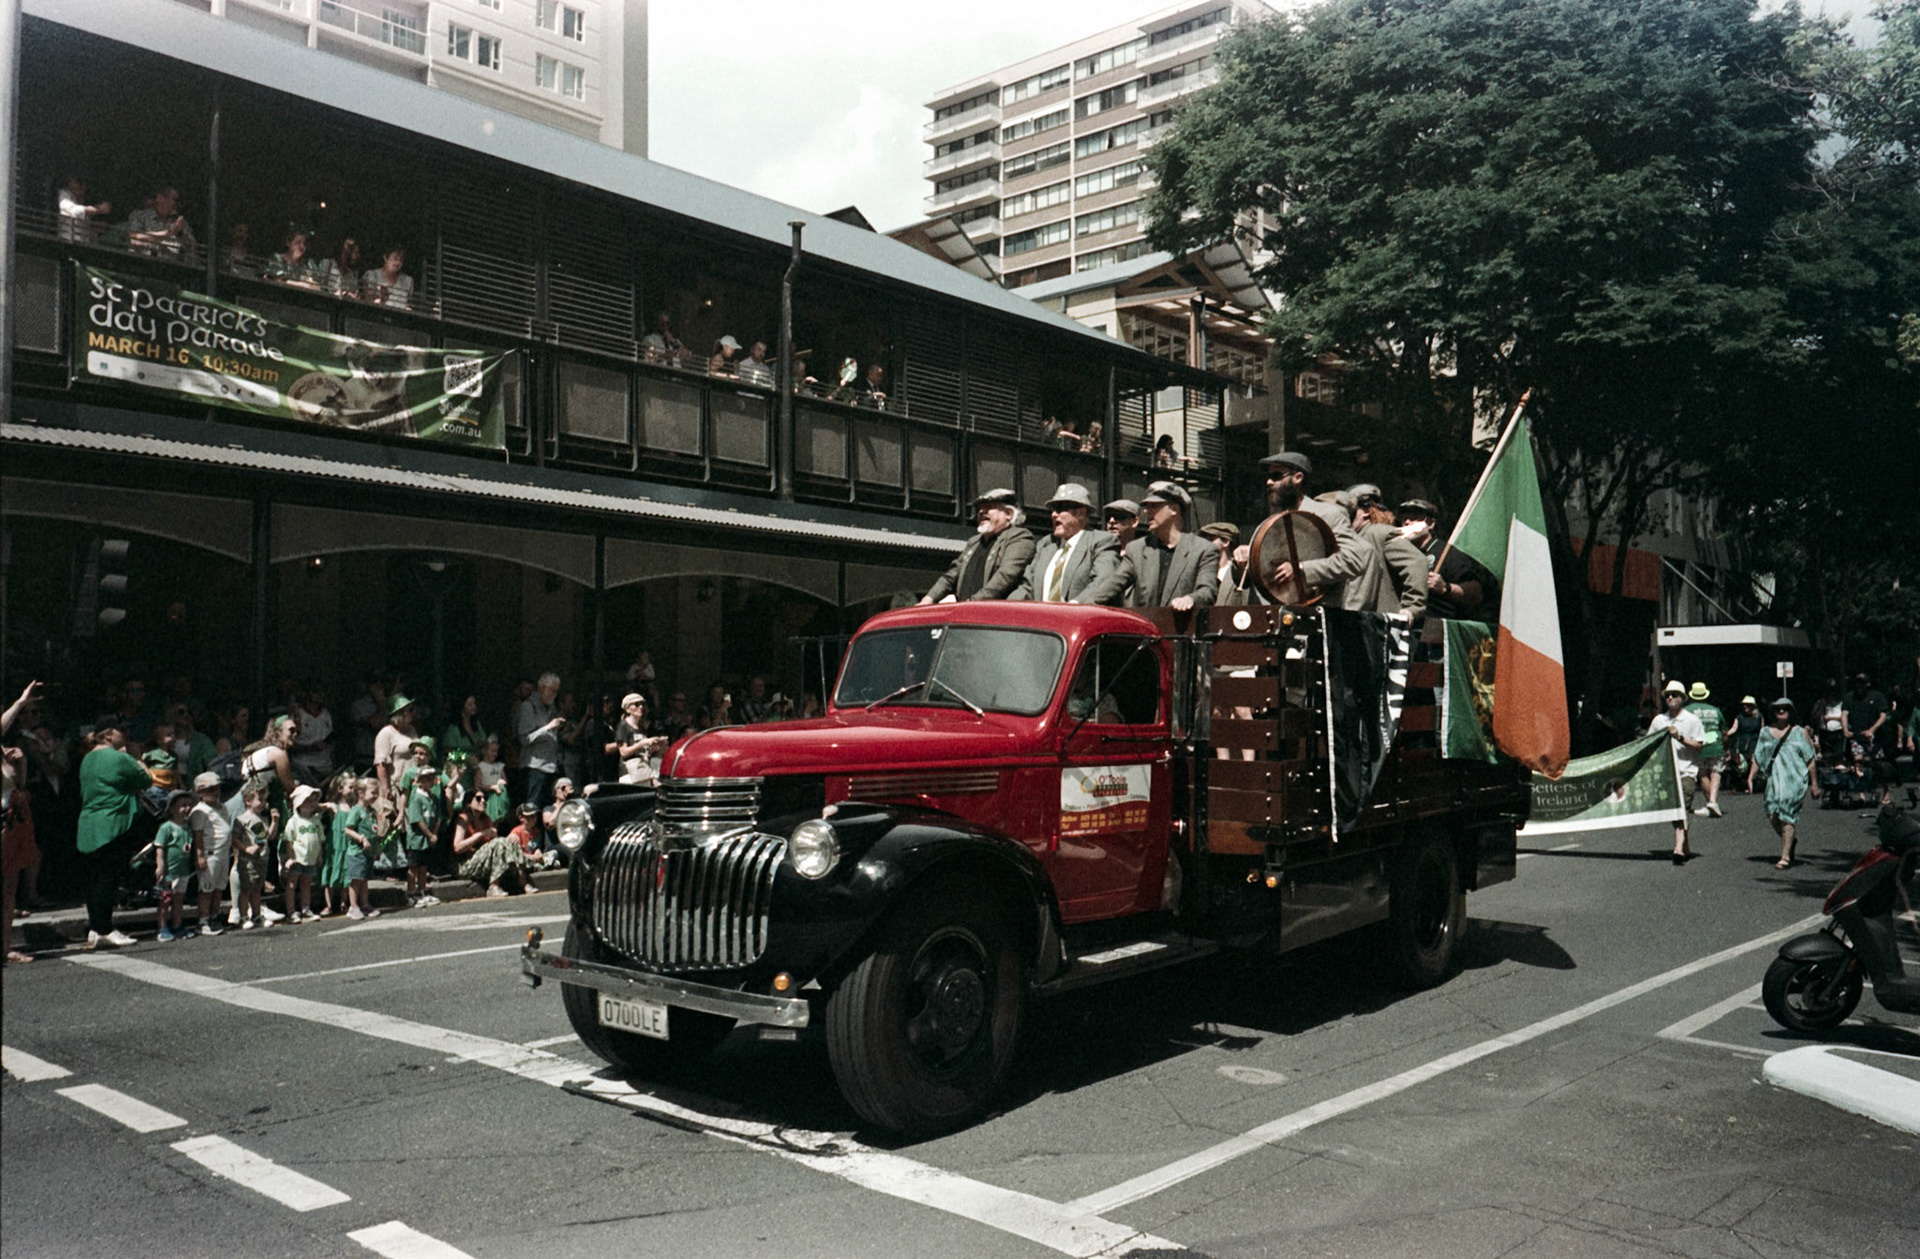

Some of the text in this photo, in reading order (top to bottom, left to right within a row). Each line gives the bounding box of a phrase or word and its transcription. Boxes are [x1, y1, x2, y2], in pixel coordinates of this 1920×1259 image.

[89, 300, 285, 362] day parade
[88, 331, 160, 360] MARCH
[166, 346, 190, 365] 16
[203, 354, 280, 383] 10:30am
[439, 422, 482, 438] .com.au
[1581, 779, 1596, 790] of
[1536, 792, 1588, 806] Ireland
